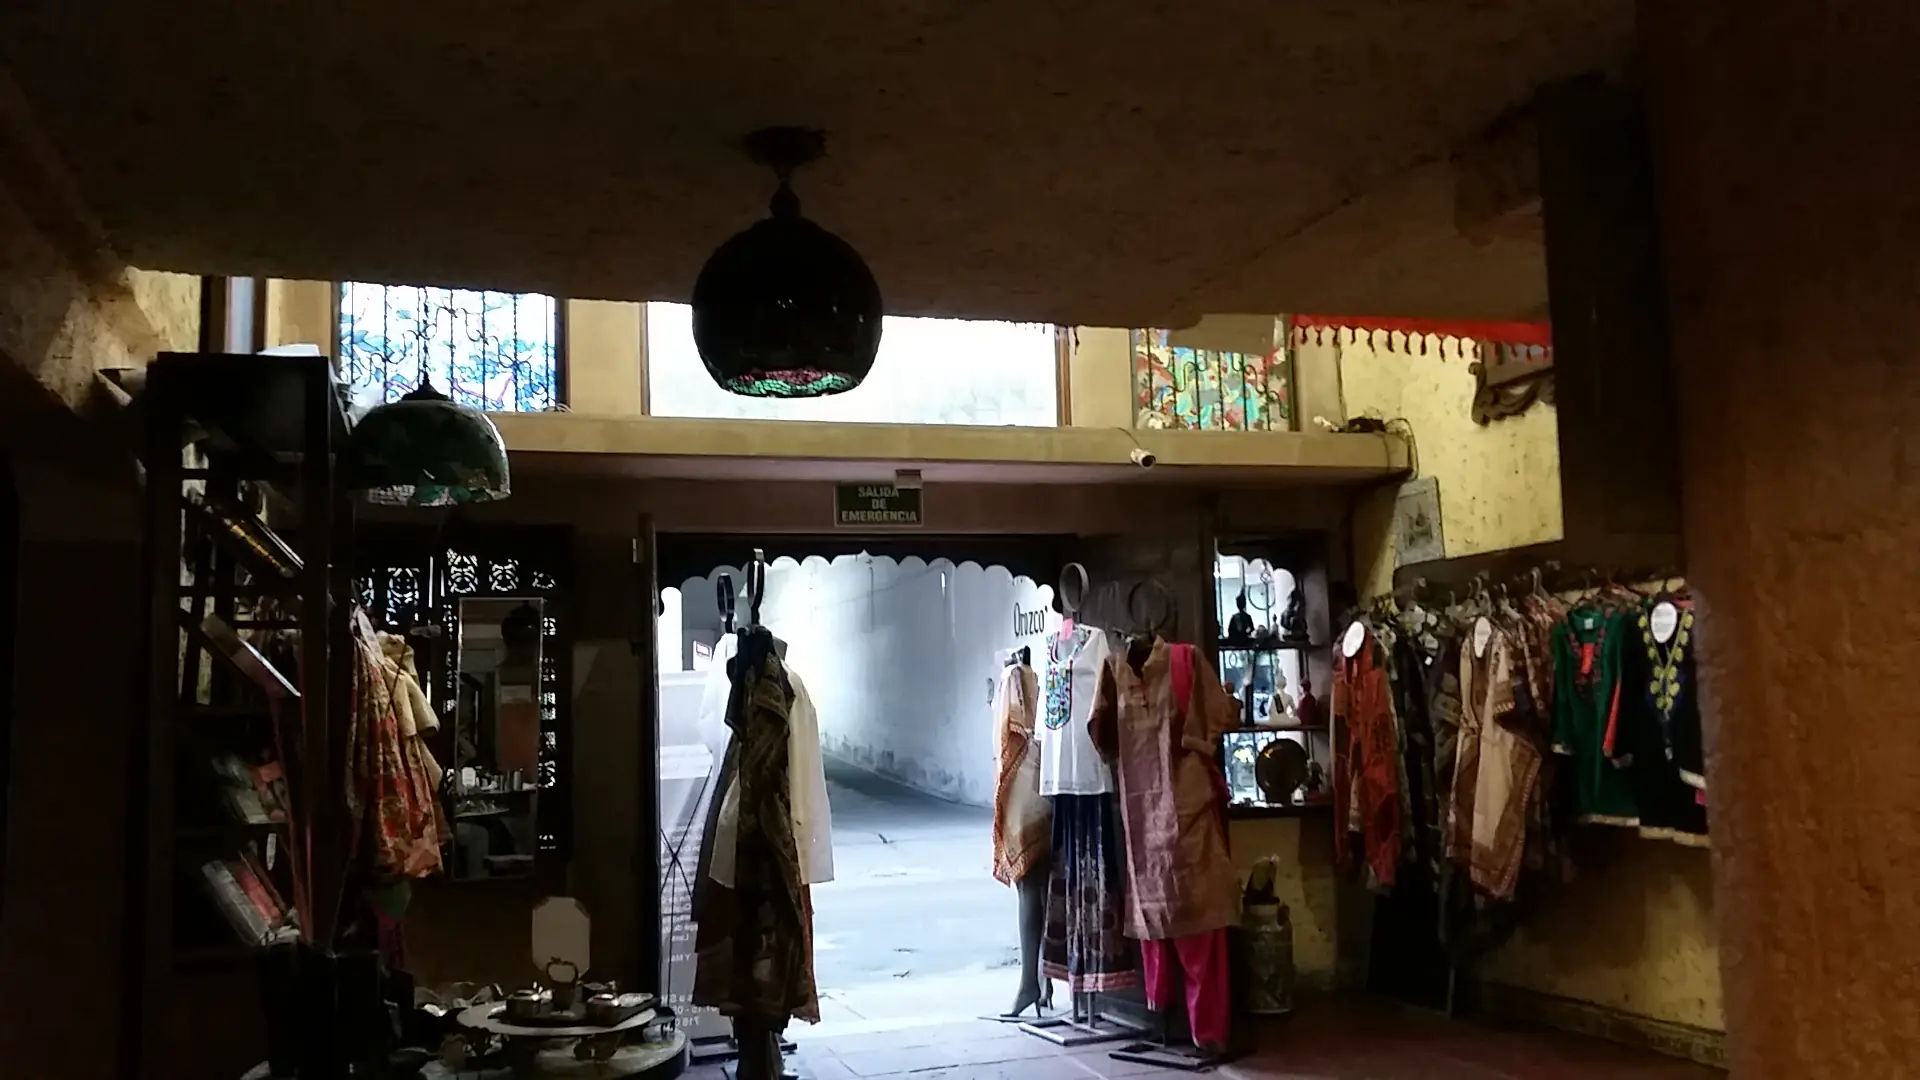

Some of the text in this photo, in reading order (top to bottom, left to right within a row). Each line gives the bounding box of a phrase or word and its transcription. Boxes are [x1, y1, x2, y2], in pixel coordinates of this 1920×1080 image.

[857, 485, 900, 498] SALIDA
[871, 498, 887, 510] DE
[841, 510, 918, 522] EMERGENCIA
